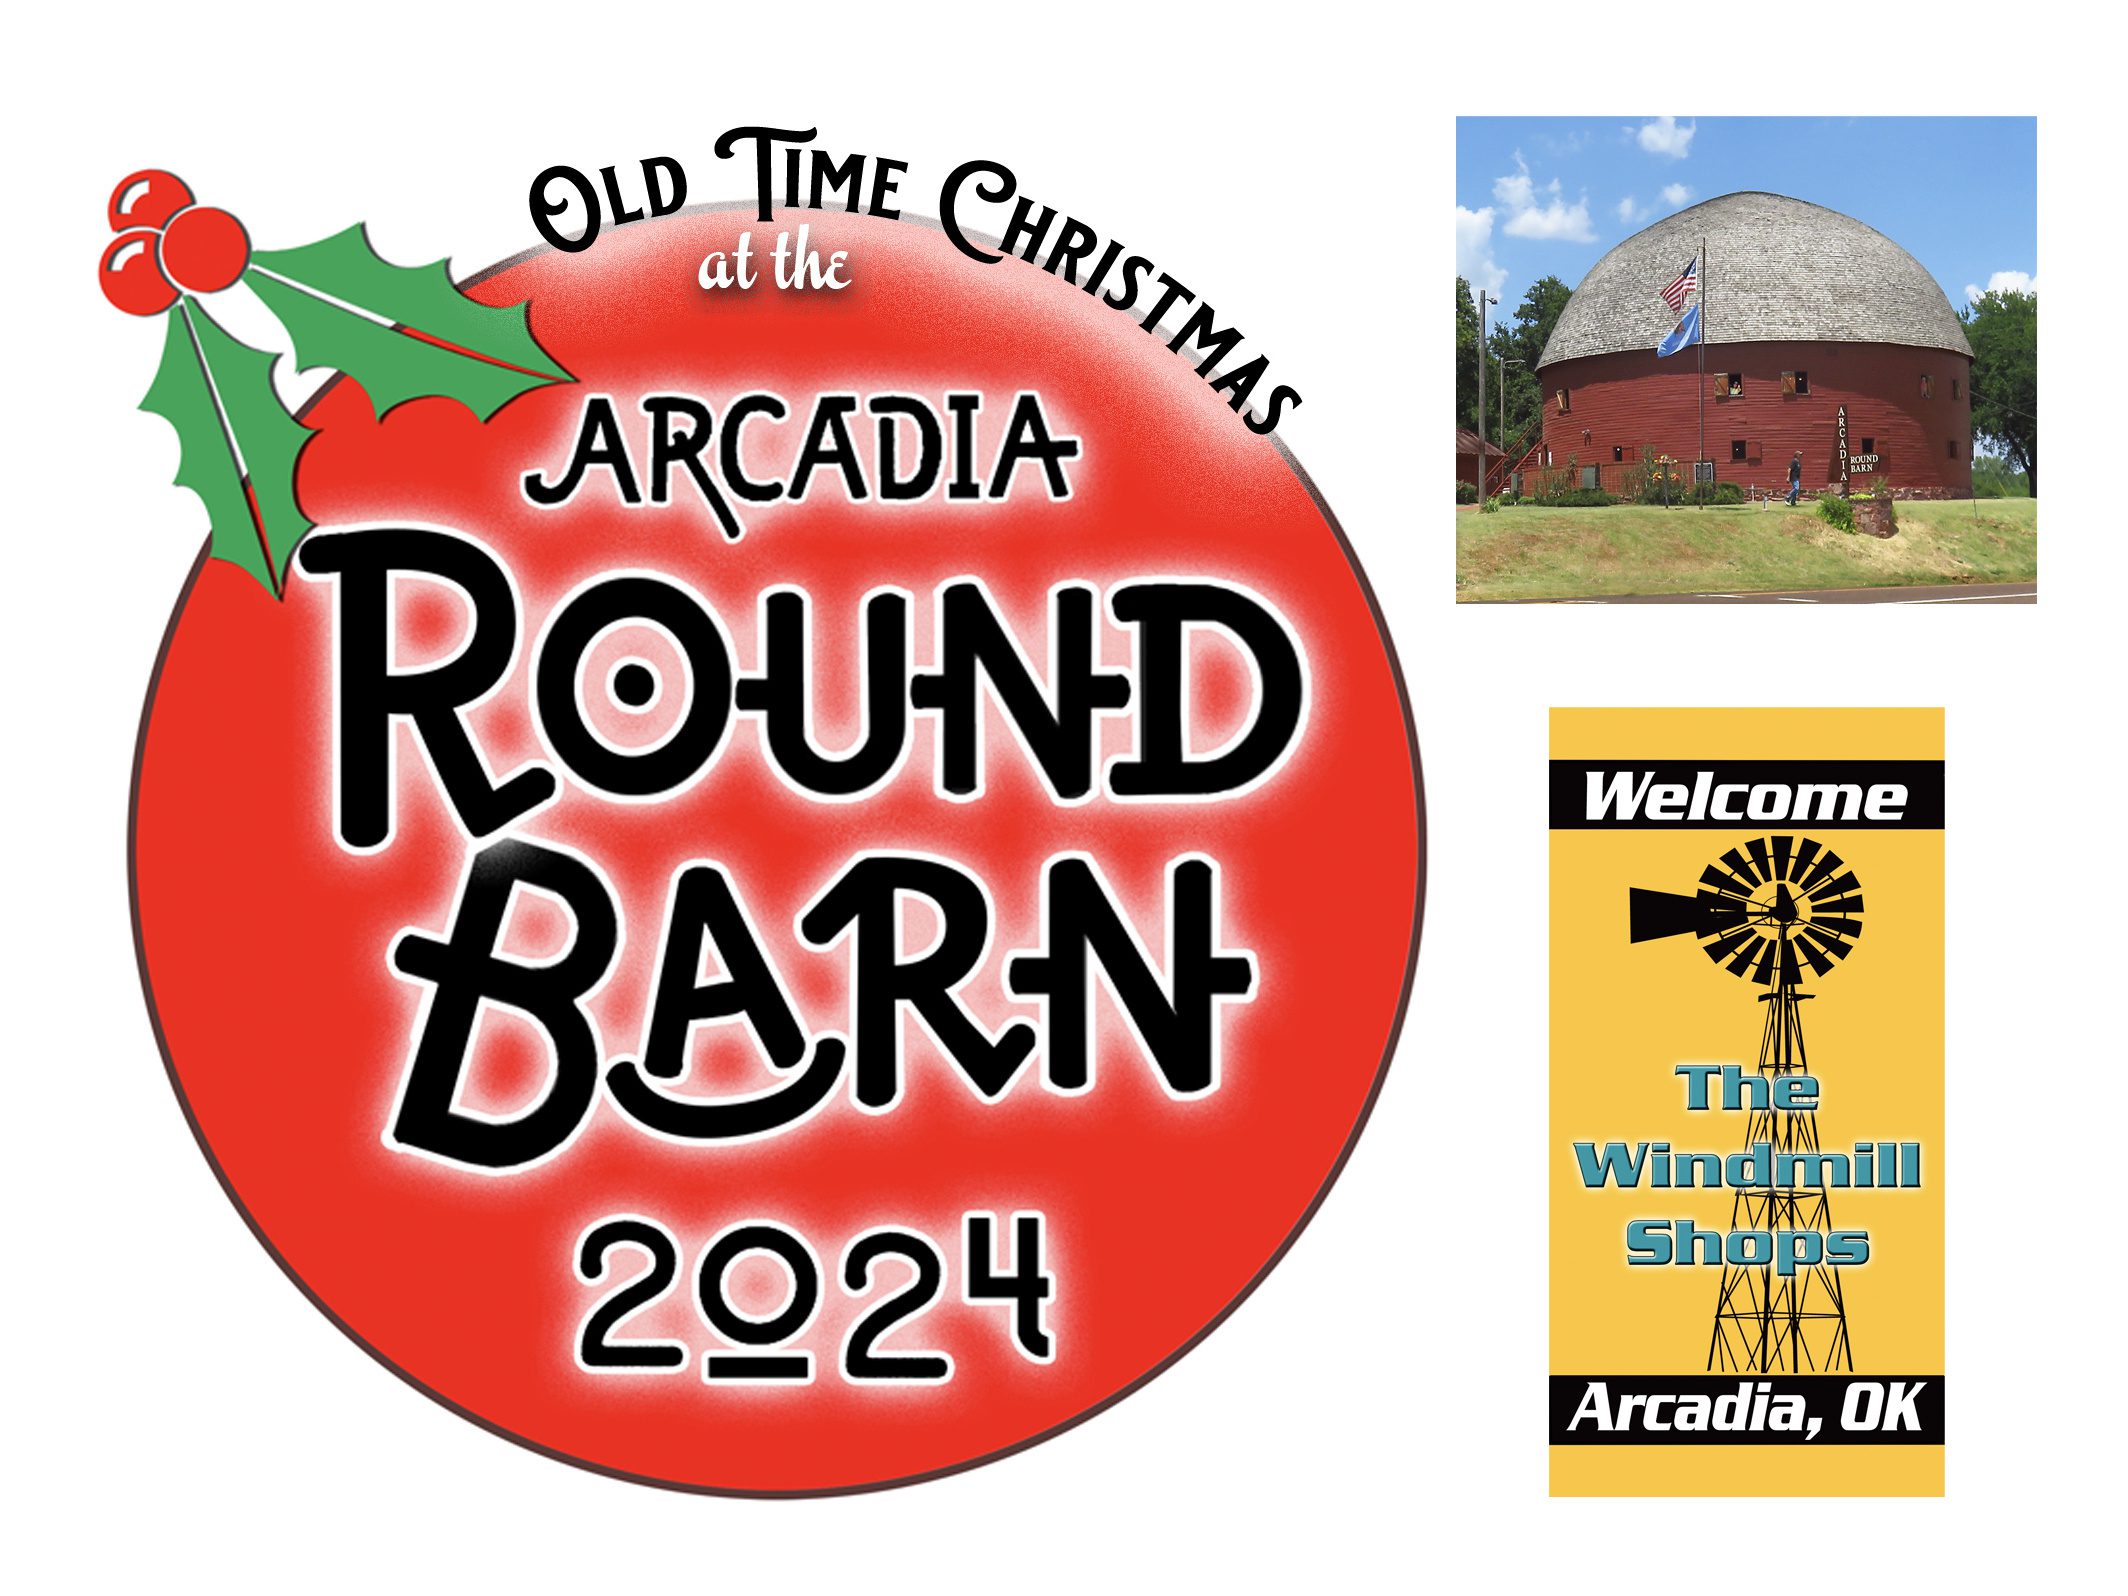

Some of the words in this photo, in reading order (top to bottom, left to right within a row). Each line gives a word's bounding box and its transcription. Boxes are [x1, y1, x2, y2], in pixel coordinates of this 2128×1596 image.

[528, 155, 687, 253] OLD
[714, 126, 908, 222] TIME
[938, 160, 1303, 435] CHRISTMAS
[697, 231, 757, 290] at
[774, 224, 852, 290] the
[522, 394, 1080, 540] ARCADIA
[1838, 406, 1847, 480] ARCADIA
[1850, 454, 1878, 464] ROUND
[1851, 463, 1873, 473] BARN
[299, 528, 1303, 847] ROUND
[1586, 771, 1908, 820] Welcome
[391, 836, 1252, 1168] BARN
[1675, 1065, 1819, 1110] The
[1573, 1143, 1921, 1188] Windmill
[1627, 1220, 1869, 1276] Shops
[579, 1216, 1049, 1379] 2024
[1566, 1382, 1823, 1440] Arcadia,
[1840, 1382, 1927, 1431] OK
